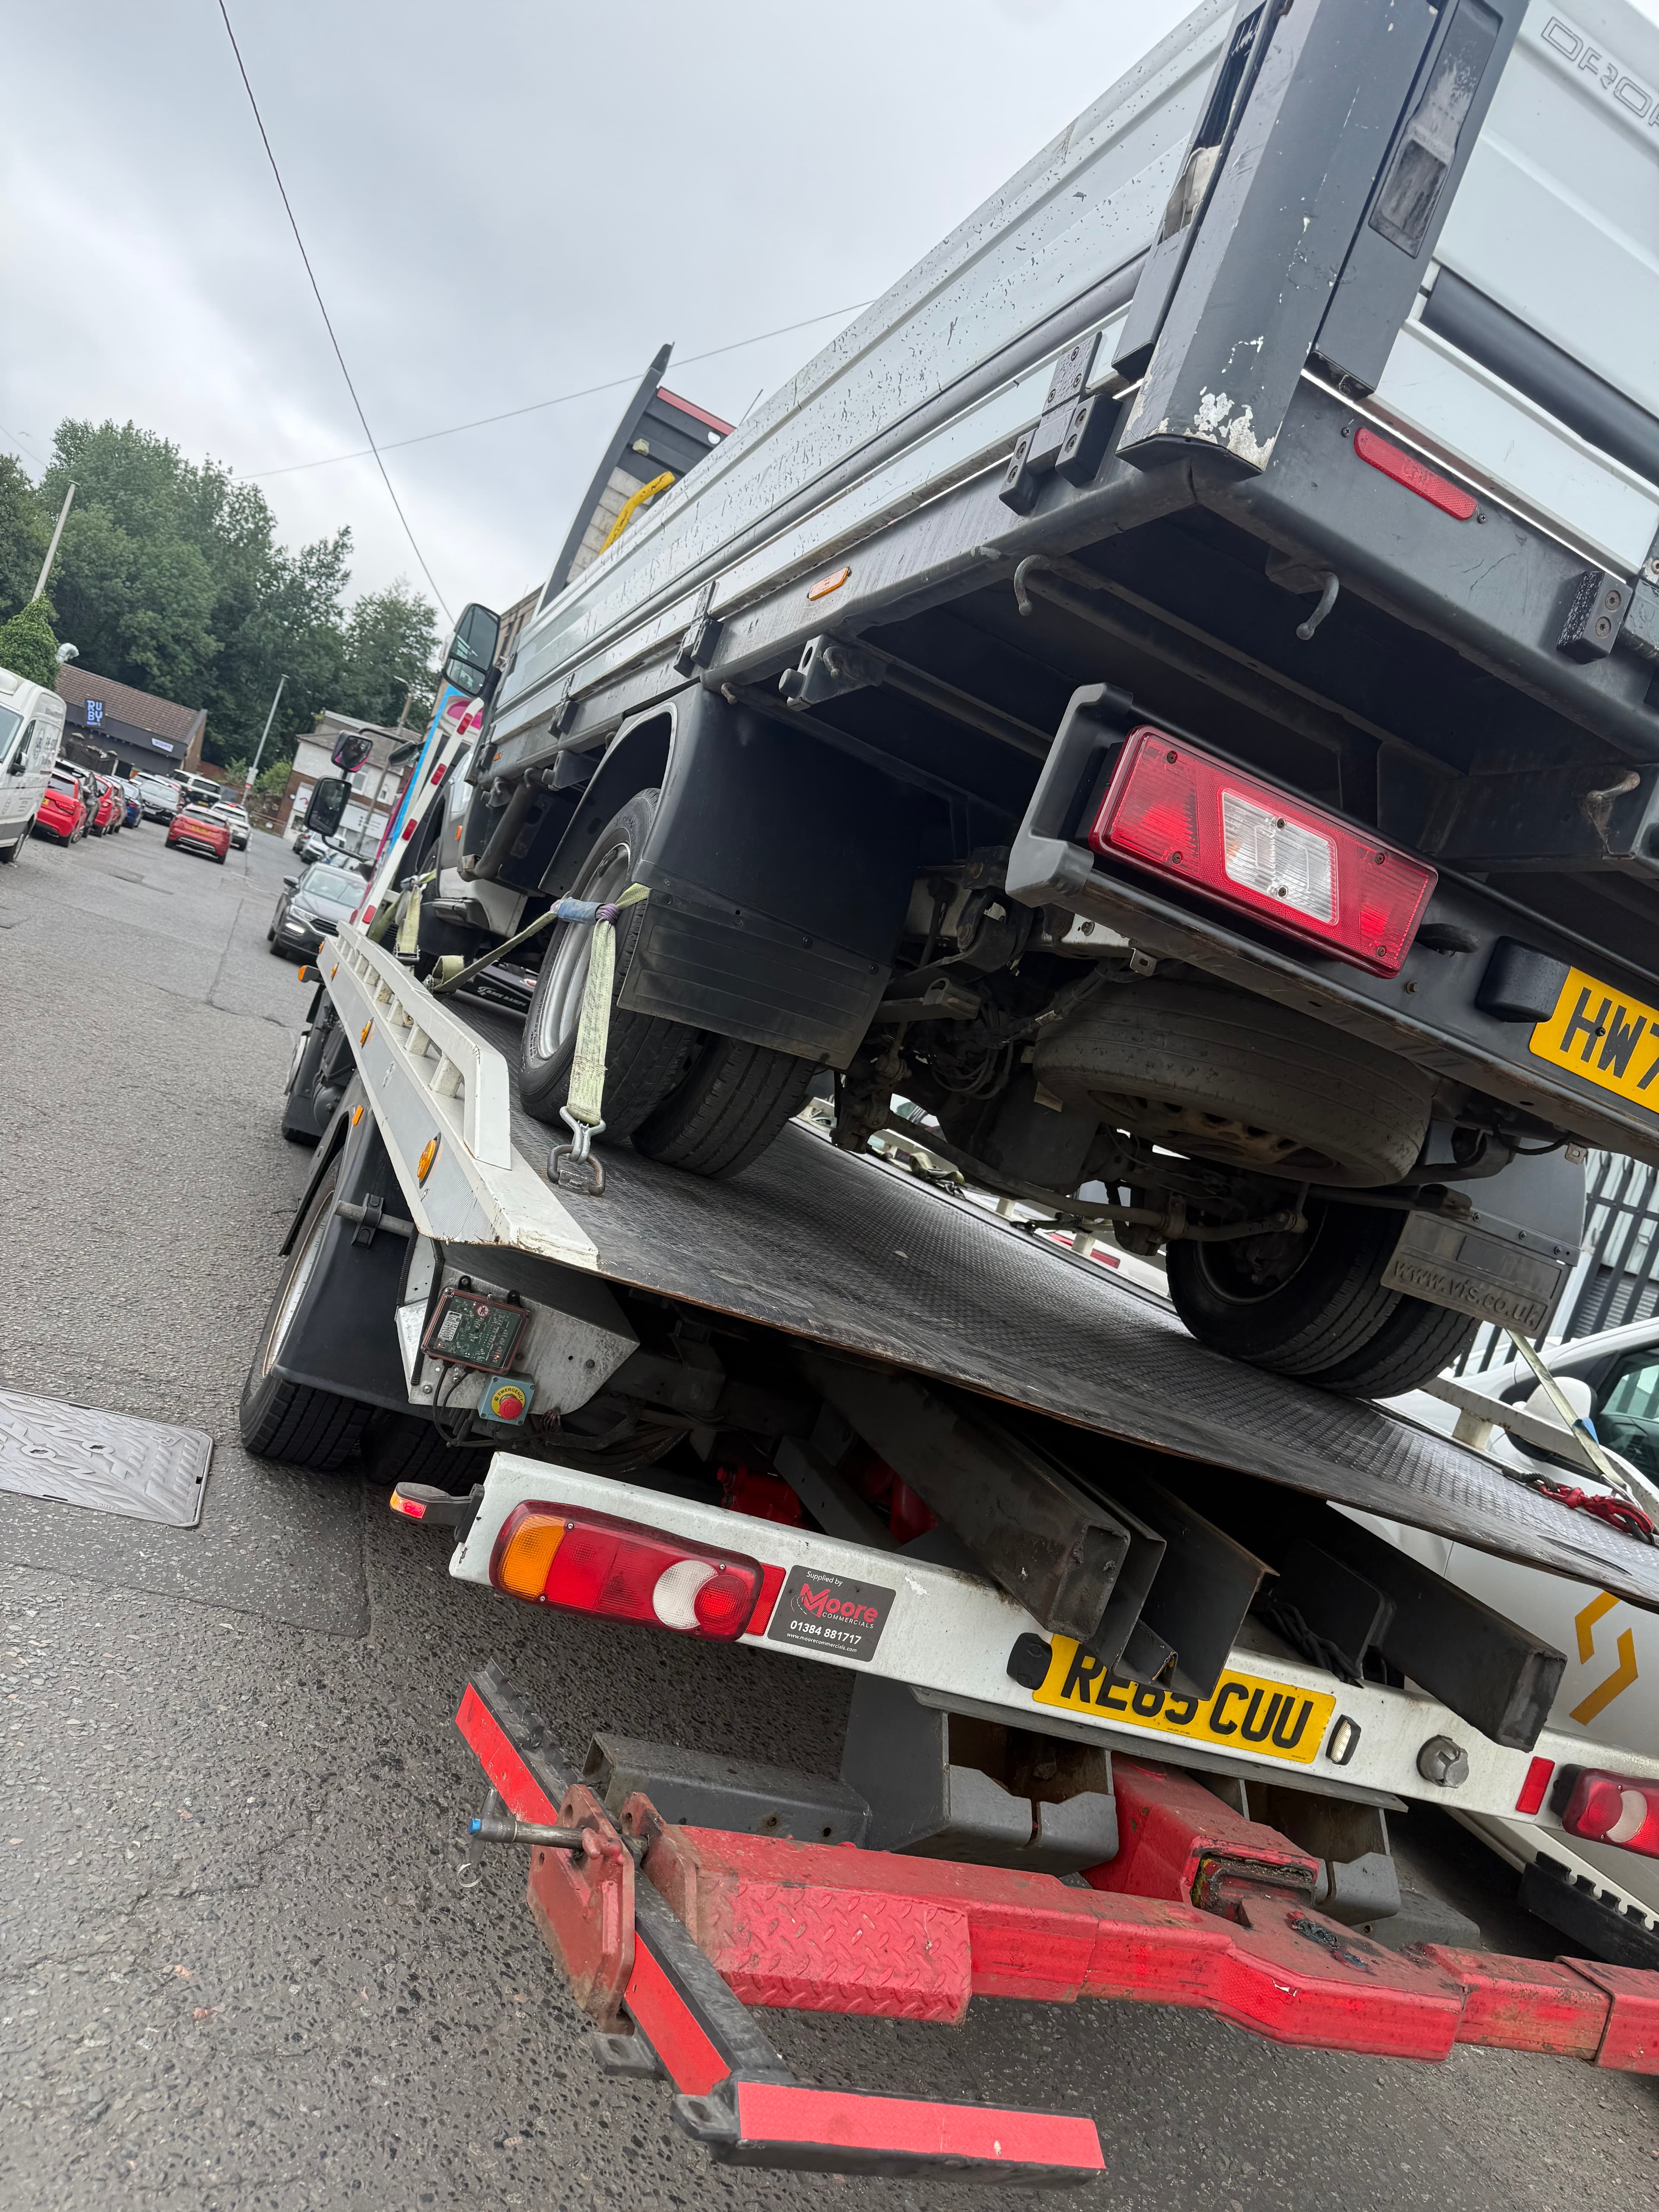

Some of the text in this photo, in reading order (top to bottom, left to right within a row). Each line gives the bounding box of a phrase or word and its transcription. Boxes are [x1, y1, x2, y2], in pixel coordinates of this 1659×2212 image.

[1394, 1260, 1539, 1327] www.vis.co.uk
[497, 1388, 524, 1401] EMERGENCY
[806, 1571, 834, 1583] Supplied
[800, 1583, 878, 1623] Moore
[822, 1612, 874, 1629] COMMERCIALS
[787, 1633, 857, 1653] www.moorecommercials.com
[790, 1620, 861, 1645] 01384 881717
[1209, 1682, 1314, 1749] CUU
